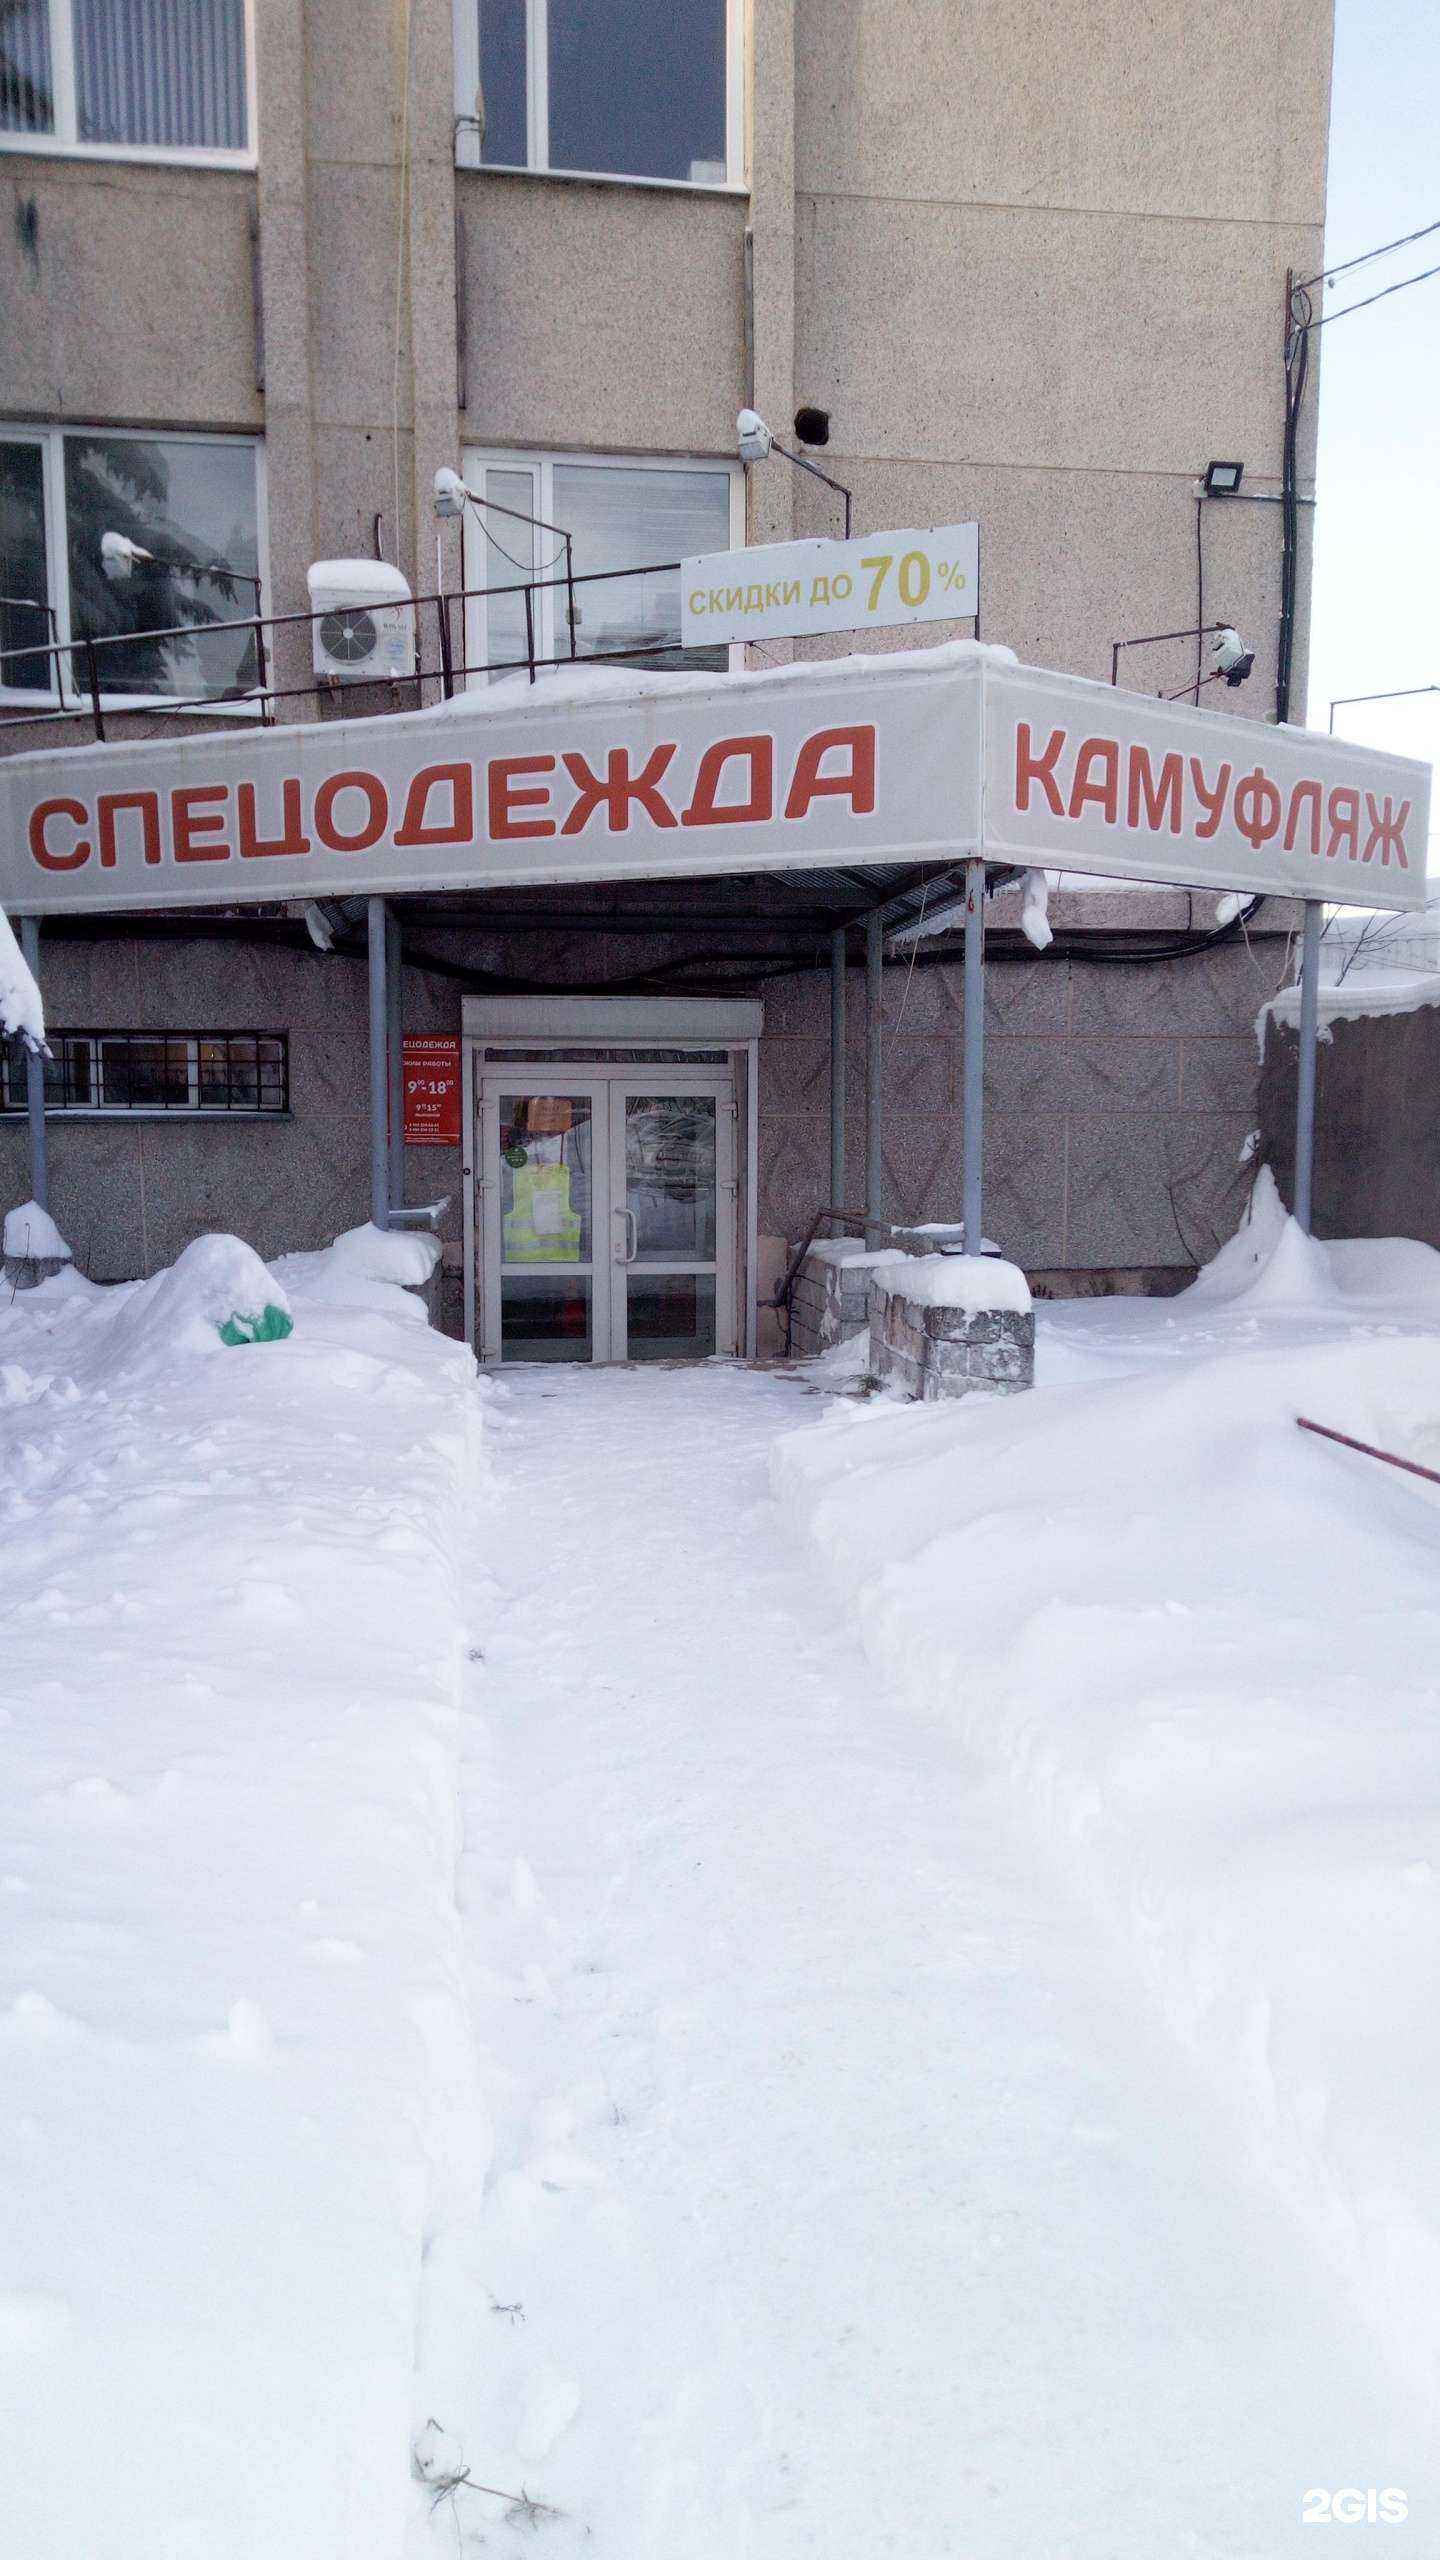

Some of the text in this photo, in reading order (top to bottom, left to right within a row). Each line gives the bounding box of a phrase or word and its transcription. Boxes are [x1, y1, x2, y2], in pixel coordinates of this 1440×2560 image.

[689, 550, 966, 615] СКИДКИ ДО 70%
[28, 725, 877, 871] СПЕЦОДЕЖДА
[1015, 722, 1411, 869] КАМУФЛЯЖ
[403, 1040, 456, 1050] ЕЦОДЕЖДА
